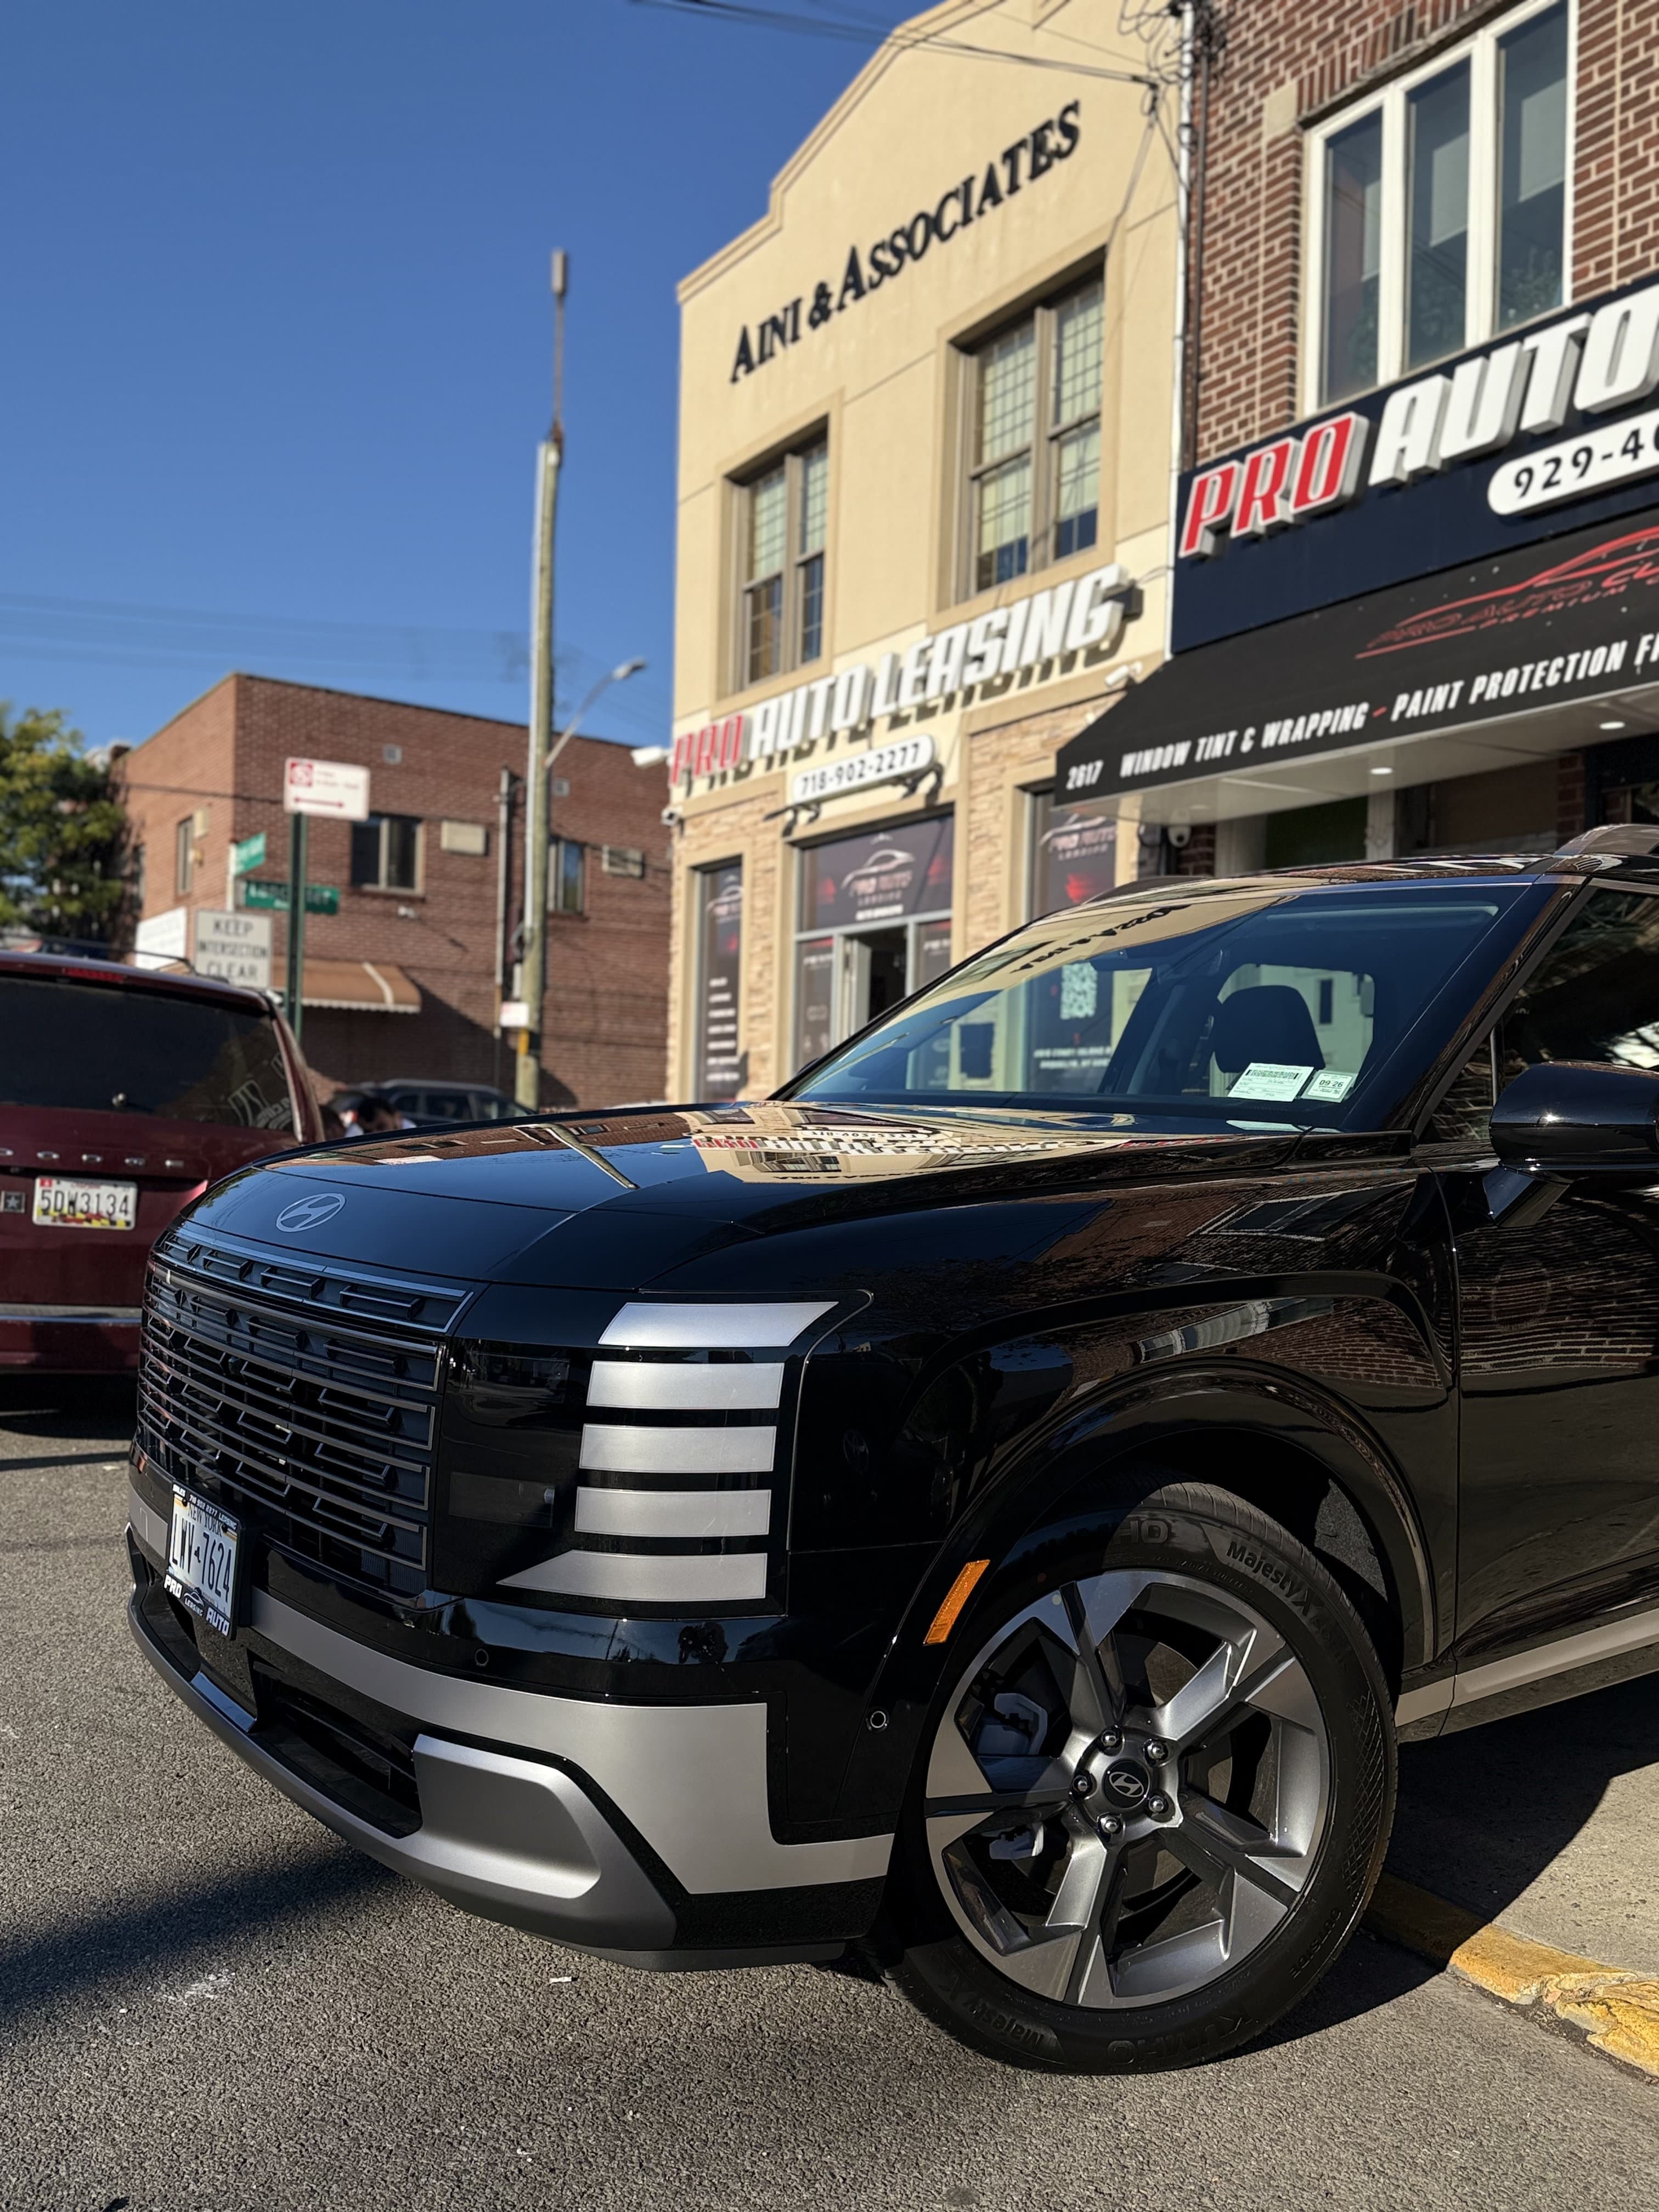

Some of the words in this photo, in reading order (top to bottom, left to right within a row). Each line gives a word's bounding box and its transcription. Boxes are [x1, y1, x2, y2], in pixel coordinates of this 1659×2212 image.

[730, 297, 803, 384] AINI
[808, 280, 833, 331] &
[836, 100, 1081, 312] ASSOCIATES
[1178, 411, 1366, 558] PRO
[1368, 283, 1659, 487] AUTO
[670, 714, 745, 787] PRO
[748, 663, 871, 761] AUTO
[871, 563, 1126, 719] LEASING
[1066, 760, 1104, 791] 2617
[1119, 740, 1193, 778] WINDOW
[1194, 730, 1238, 762] TINT
[1261, 702, 1372, 748] WRAPPING
[1392, 680, 1465, 722] PAINT
[1469, 640, 1628, 706] PROTECTION
[799, 742, 921, 797] 718-902-2277
[199, 940, 269, 959] INTERSECTION
[213, 919, 254, 937] KEEP
[207, 960, 258, 982] CLEAR
[1331, 1080, 1345, 1088] 26
[40, 1189, 129, 1216] 5DW3134
[188, 1503, 203, 1524] NEW
[202, 1511, 222, 1538] YORK
[201, 1531, 233, 1604] 7624
[163, 1574, 183, 1599] PRO
[184, 1599, 204, 1617] LEASING
[206, 1606, 230, 1637] AUTO
